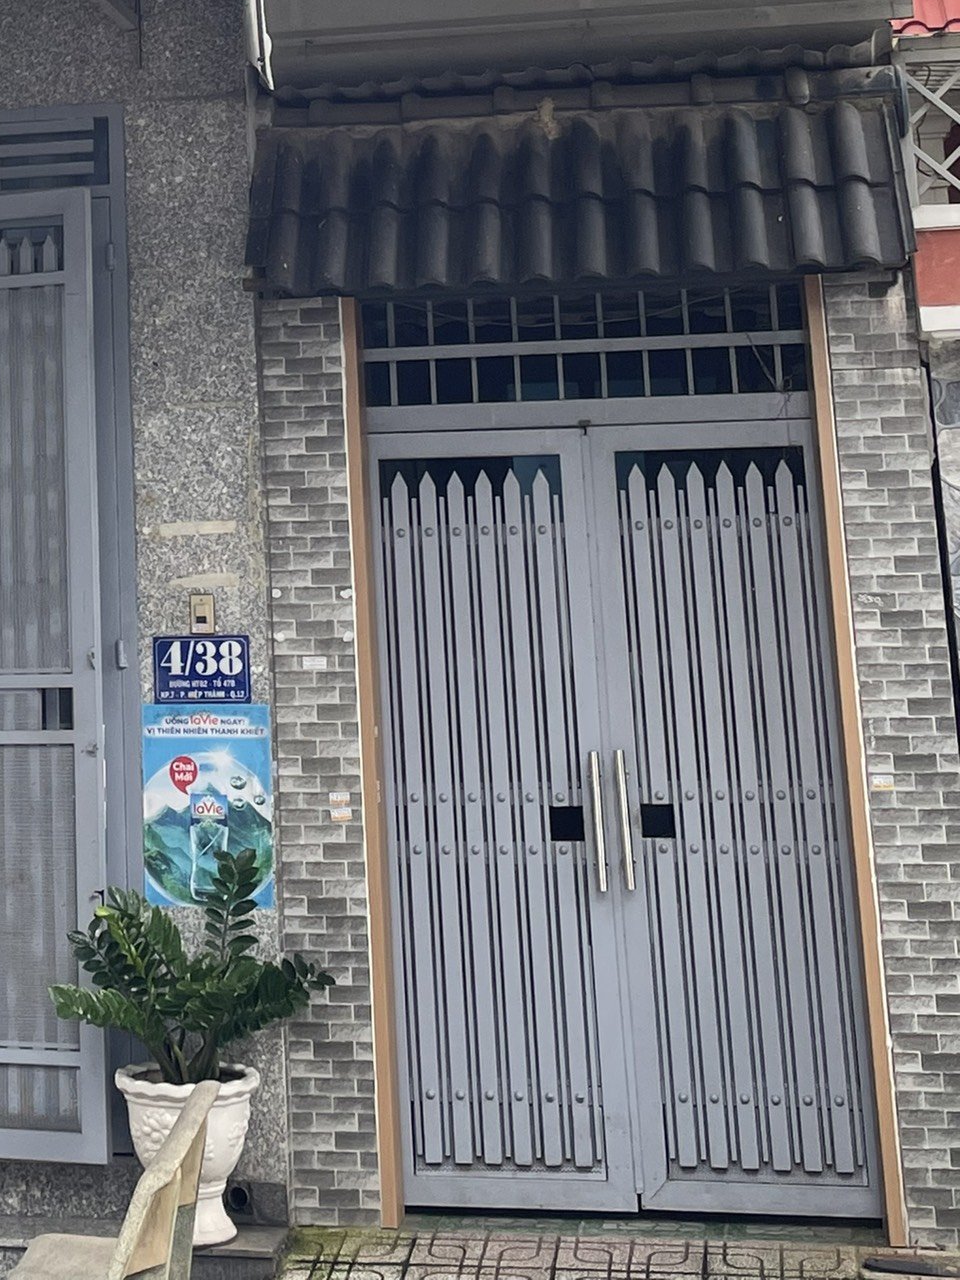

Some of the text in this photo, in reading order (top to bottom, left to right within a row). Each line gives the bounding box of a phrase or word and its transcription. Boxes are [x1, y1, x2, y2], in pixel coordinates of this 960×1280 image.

[160, 640, 243, 676] 4/38
[157, 726, 181, 735] THIÊN
[183, 726, 208, 735] NHIÊN
[240, 726, 265, 736] KHIẾT
[172, 761, 194, 771] Chai
